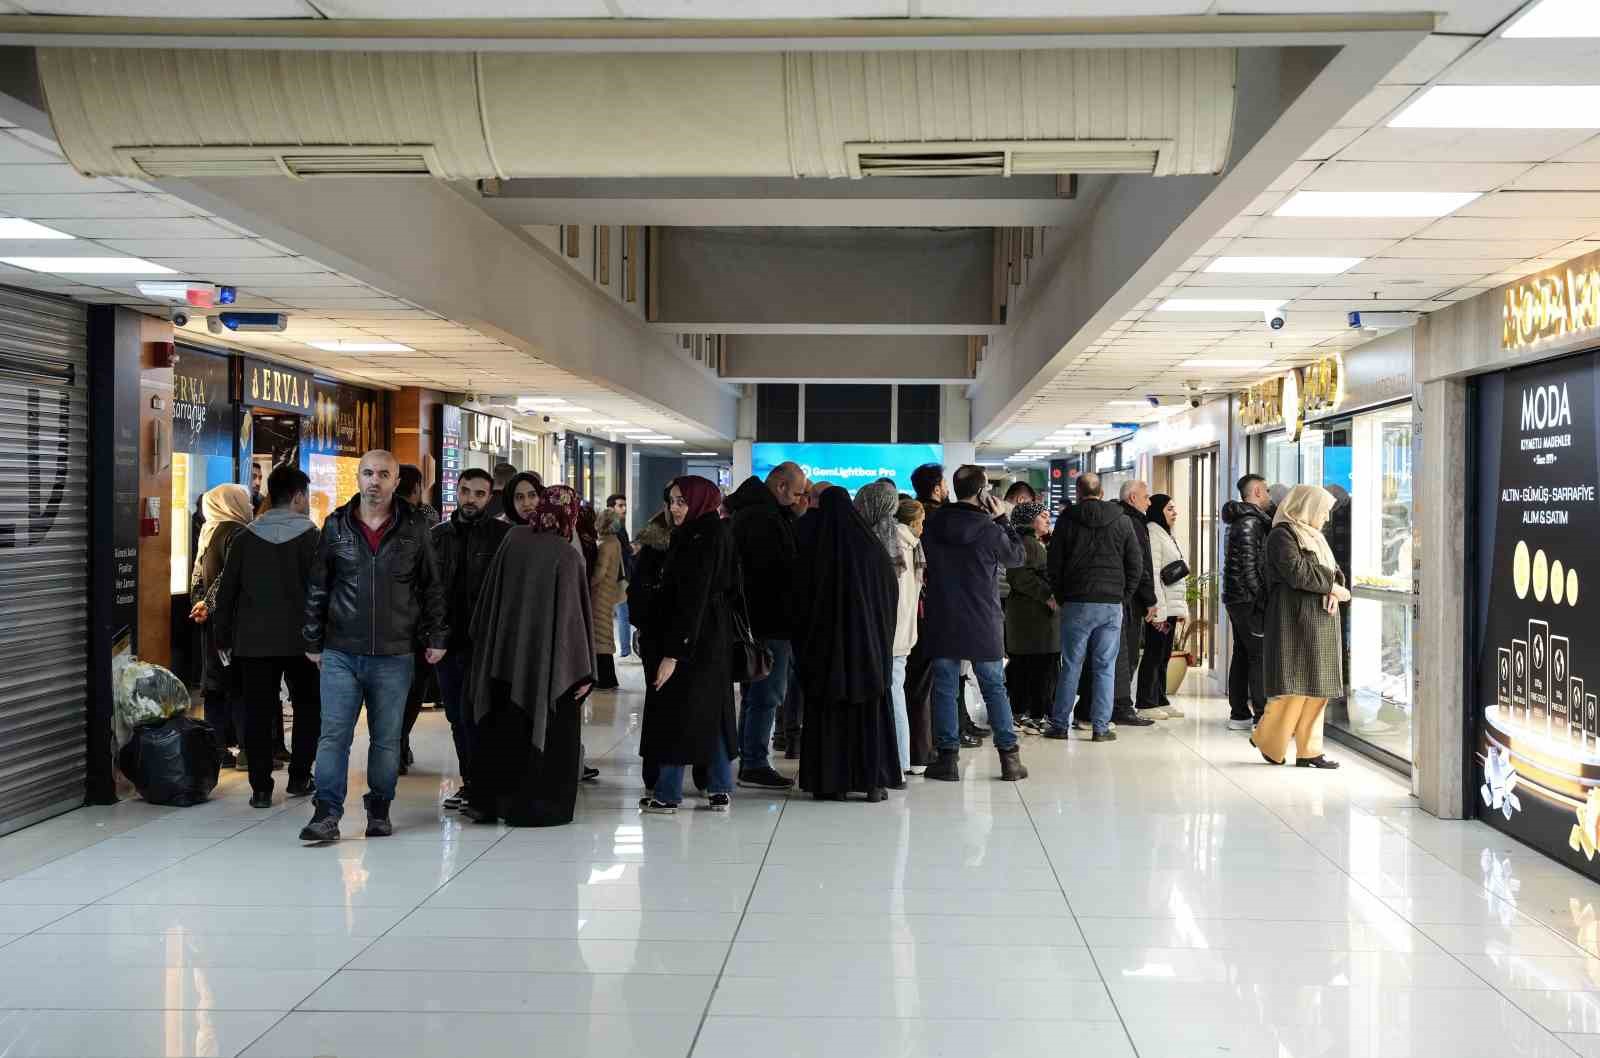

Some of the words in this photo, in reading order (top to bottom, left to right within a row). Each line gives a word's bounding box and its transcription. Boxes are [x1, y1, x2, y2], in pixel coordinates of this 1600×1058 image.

[263, 368, 299, 407] ERVA
[1520, 382, 1572, 431] MODA
[879, 466, 896, 477] Pro
